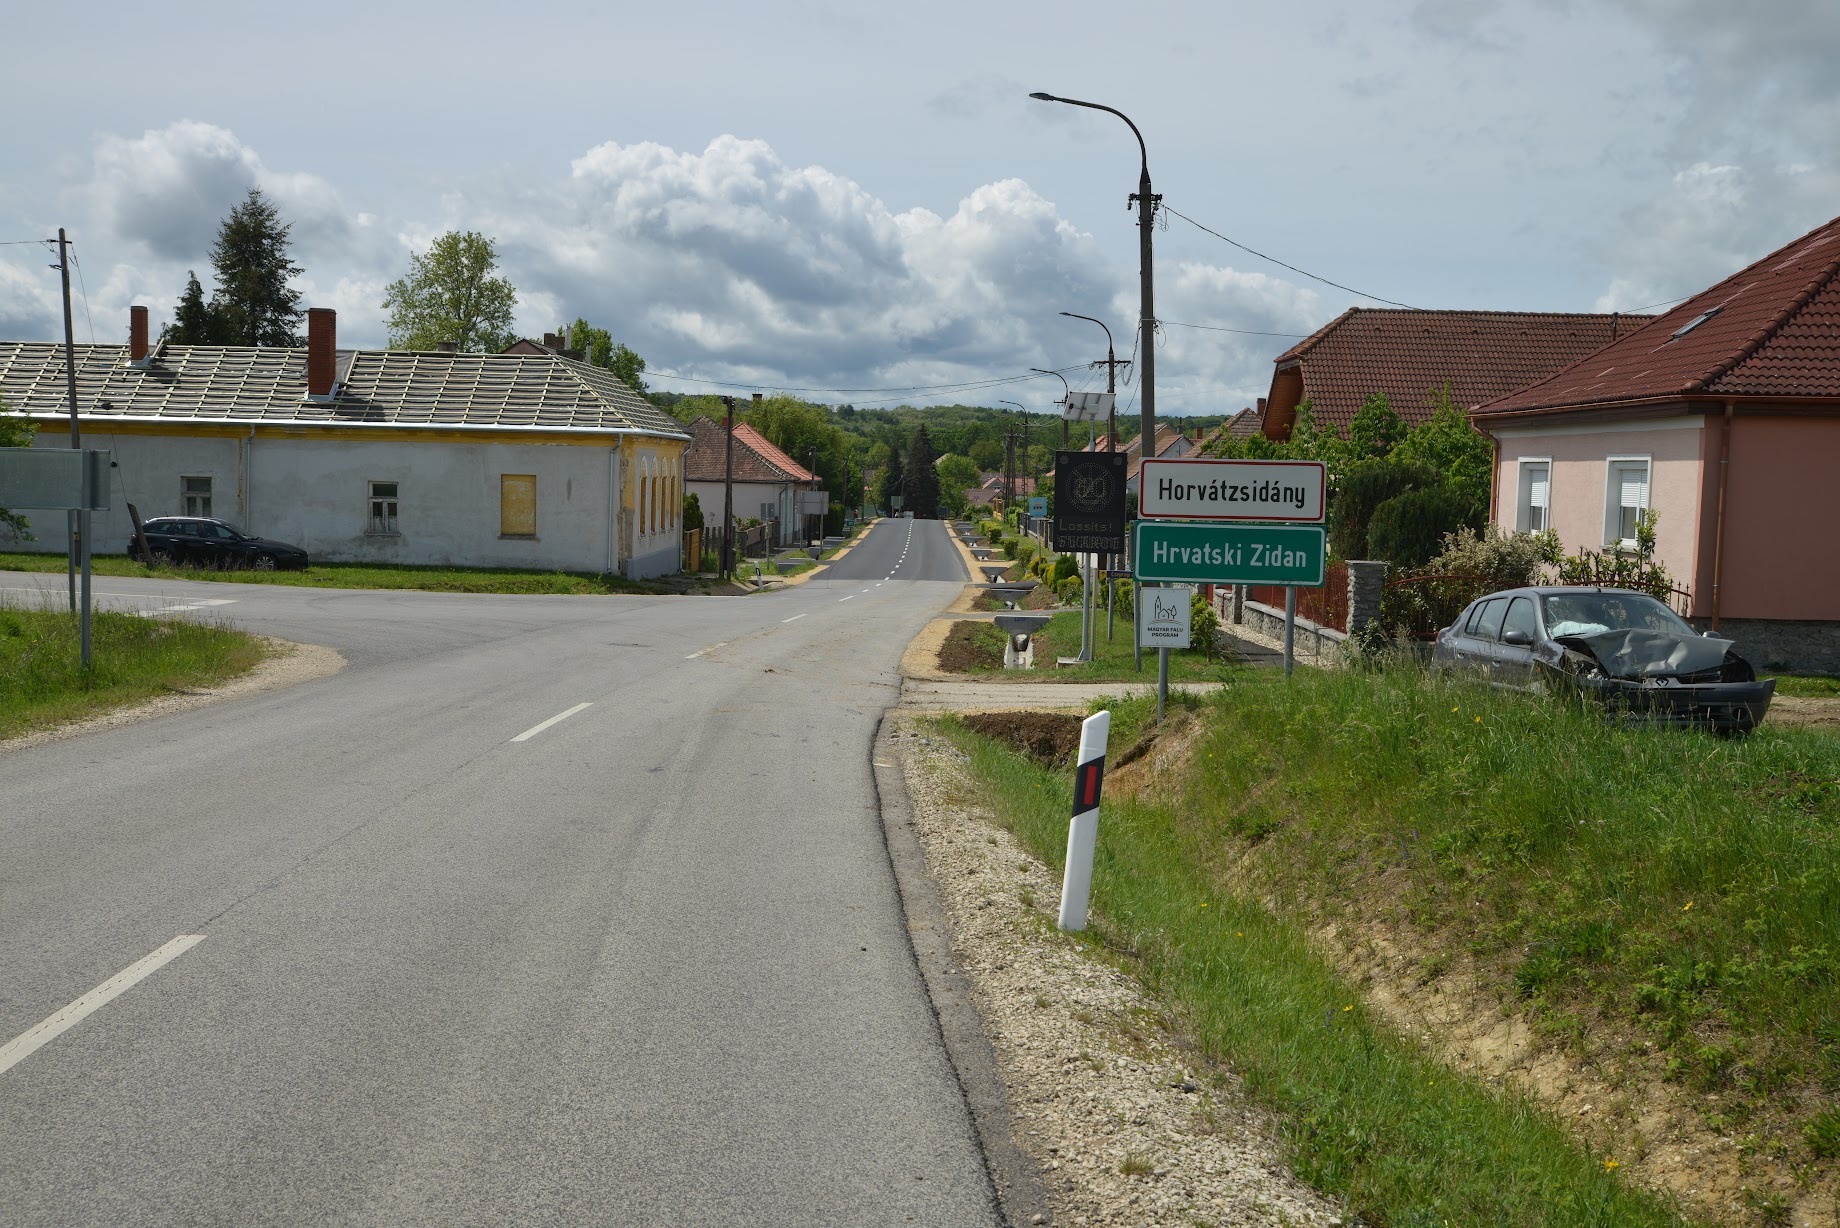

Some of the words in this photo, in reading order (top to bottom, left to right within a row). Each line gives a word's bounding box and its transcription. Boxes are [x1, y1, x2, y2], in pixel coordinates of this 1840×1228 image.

[1159, 478, 1305, 508] Horvátzsidány
[1153, 541, 1242, 565] Hrvatski
[1250, 544, 1307, 568] Zidan
